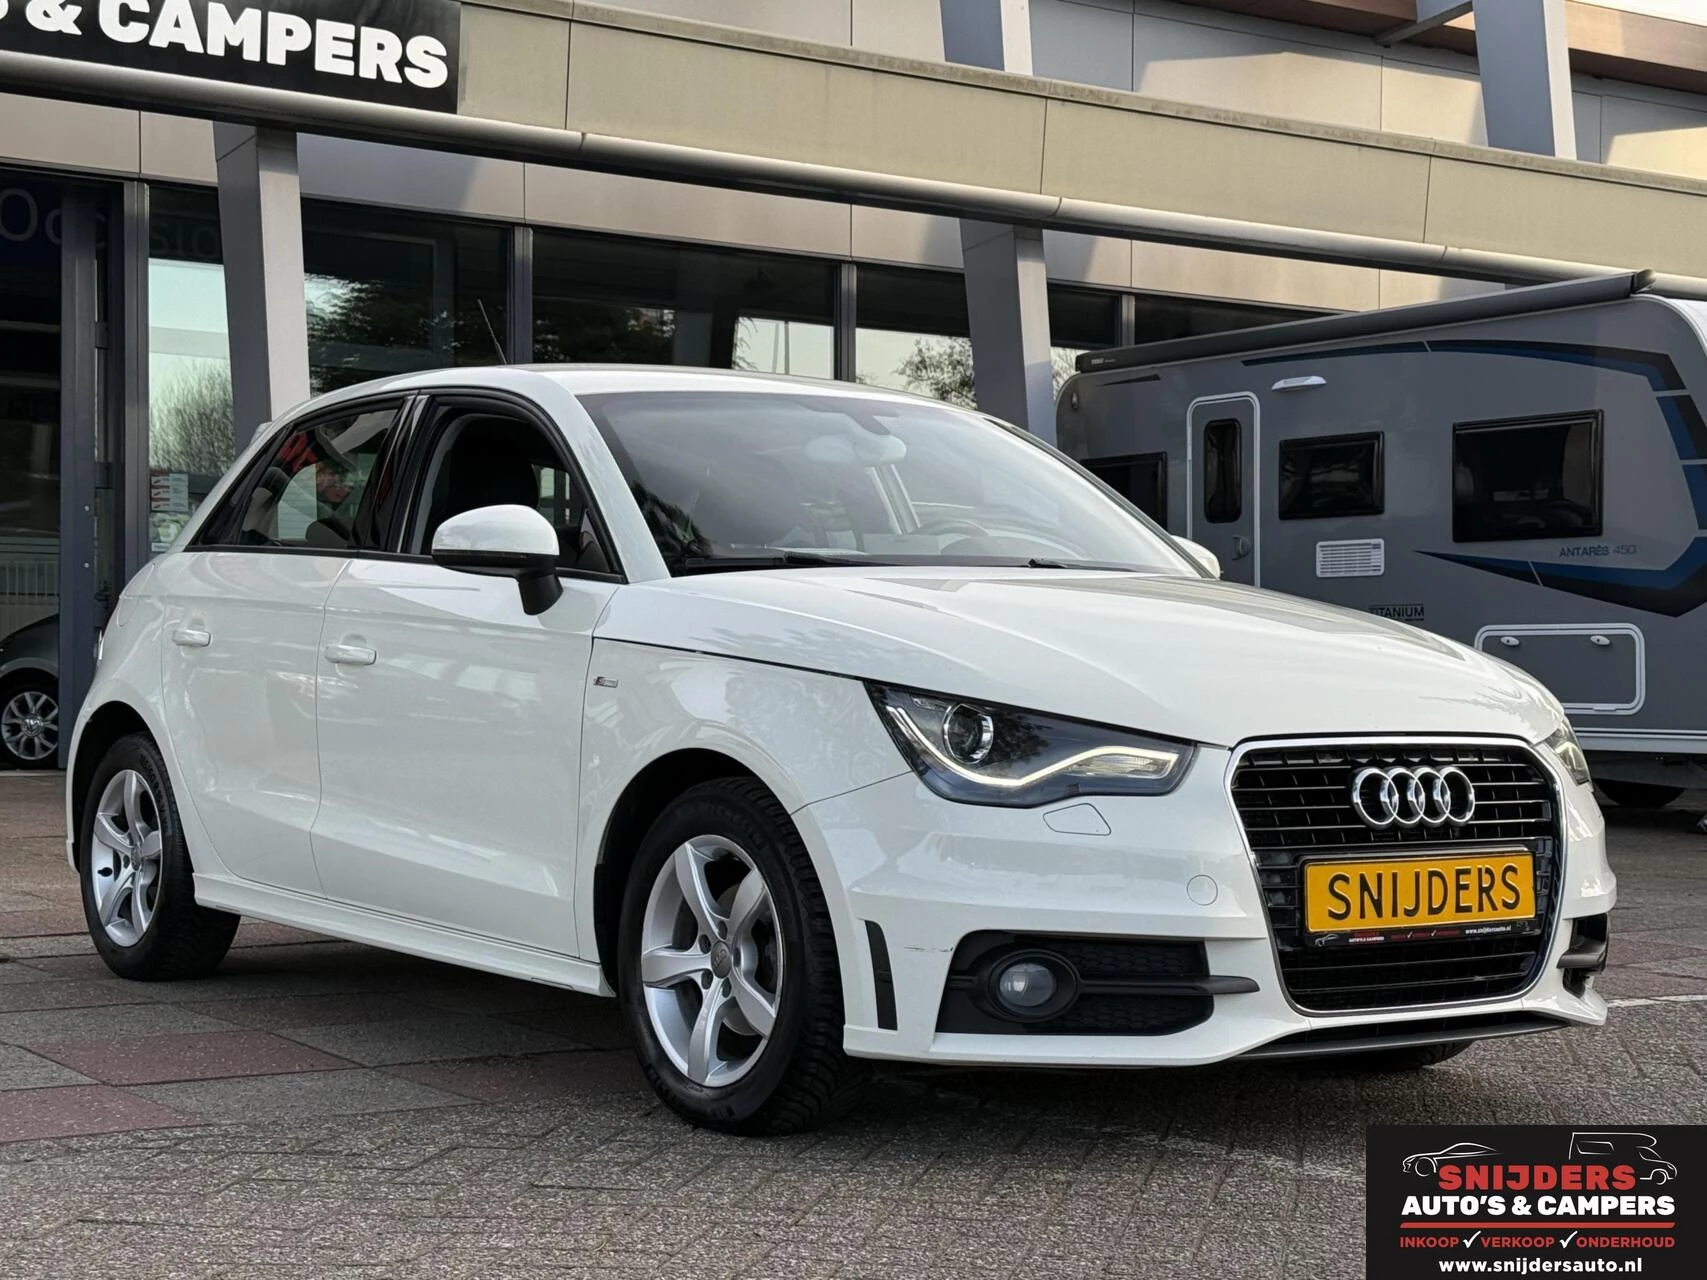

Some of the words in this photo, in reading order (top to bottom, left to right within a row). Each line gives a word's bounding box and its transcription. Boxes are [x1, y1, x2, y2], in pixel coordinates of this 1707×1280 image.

[25, 0, 82, 36] &
[98, 0, 449, 89] CAMPERS
[1612, 543, 1637, 555] 450
[1327, 862, 1521, 921] SNIJDERS
